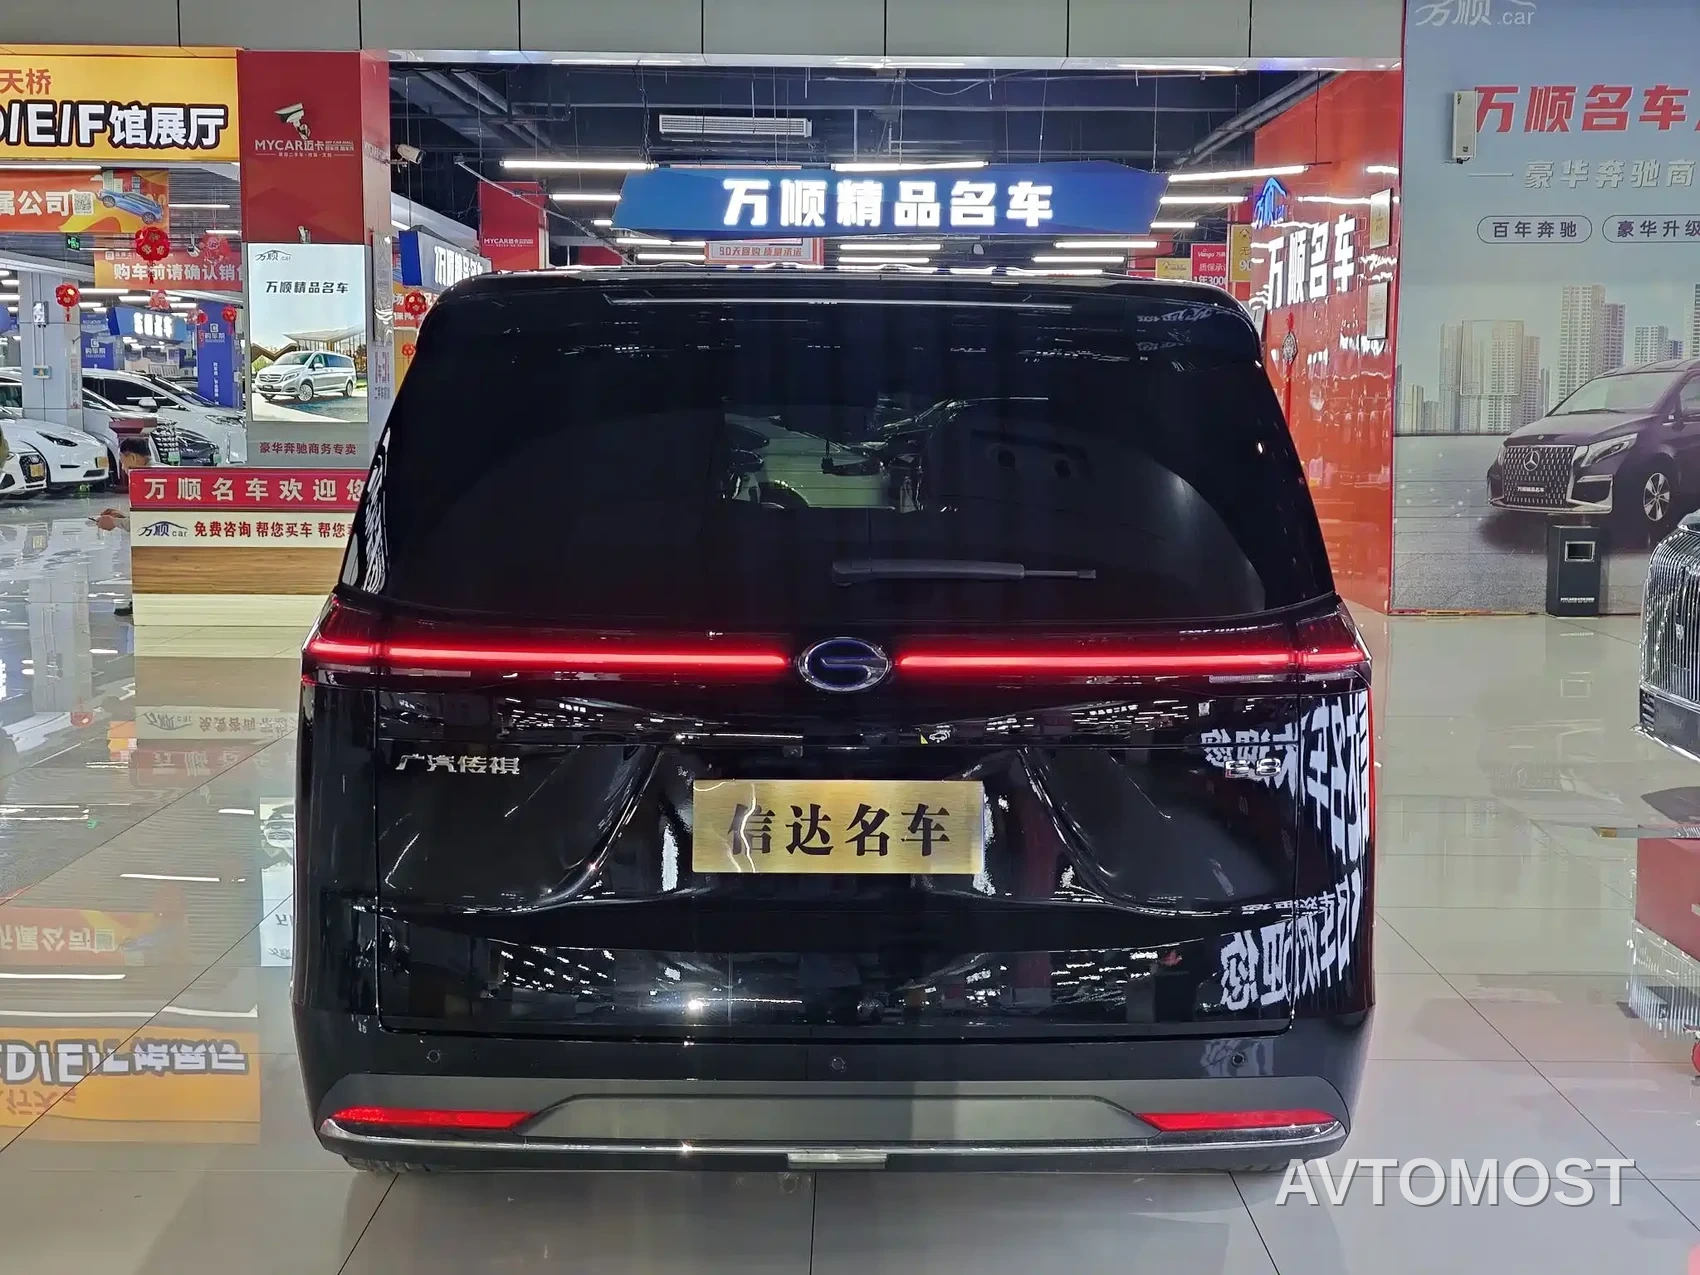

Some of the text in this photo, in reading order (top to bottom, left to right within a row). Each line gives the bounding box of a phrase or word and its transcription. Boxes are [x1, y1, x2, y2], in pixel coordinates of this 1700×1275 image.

[0, 68, 52, 95] 天桥
[1475, 84, 1700, 133] 万顺名车
[0, 102, 225, 148] /E/F馆展厅
[1523, 158, 1696, 189] 豪华奔驰商
[722, 179, 1054, 228] 万顺精品名车
[1492, 219, 1700, 239] 百年奔驰 豪华升级
[1266, 213, 1357, 311] 万顺名车
[265, 281, 349, 294] 万顺精品名车
[259, 442, 357, 455] 豪华奔驰商务专卖
[143, 477, 366, 502] 万顺名车欢迎您
[194, 521, 252, 538] 免费咨询
[255, 521, 313, 539] 帮您买车
[395, 753, 521, 775] 广汽传祺
[727, 803, 951, 858] 信达名车
